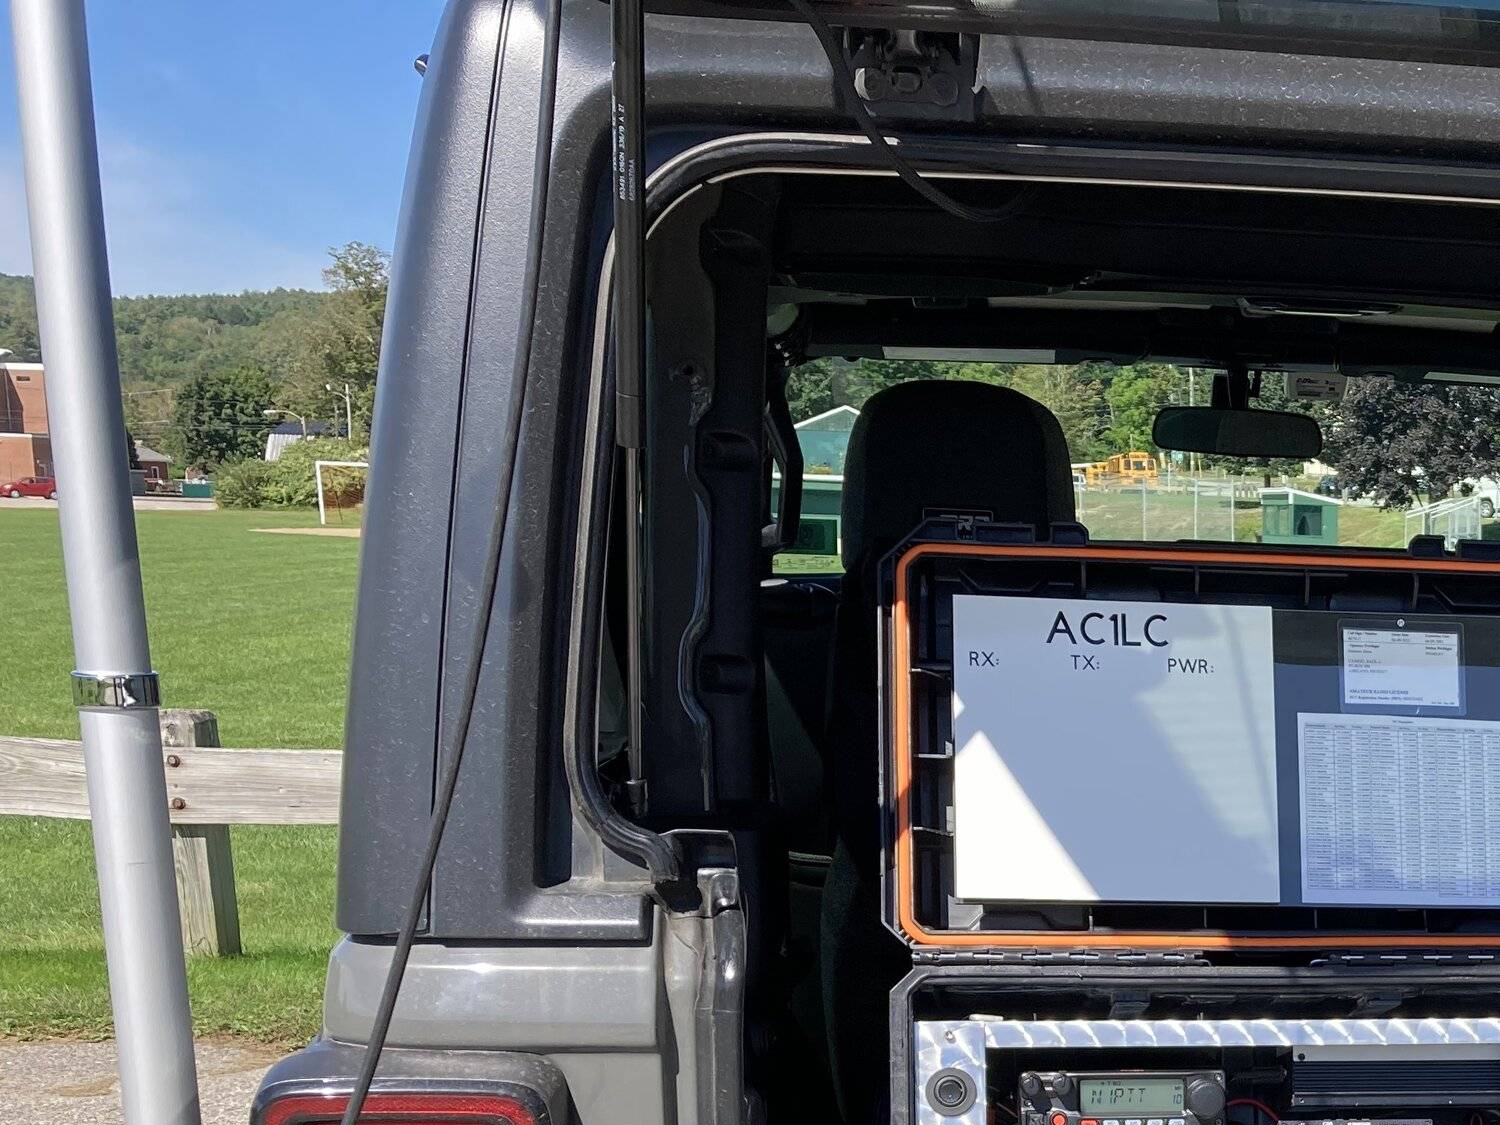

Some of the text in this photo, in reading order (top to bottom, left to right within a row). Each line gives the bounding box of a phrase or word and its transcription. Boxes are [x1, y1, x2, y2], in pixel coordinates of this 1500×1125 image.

[1046, 611, 1169, 647] AC1LC
[969, 651, 1215, 674] RX: TX: PWR:
